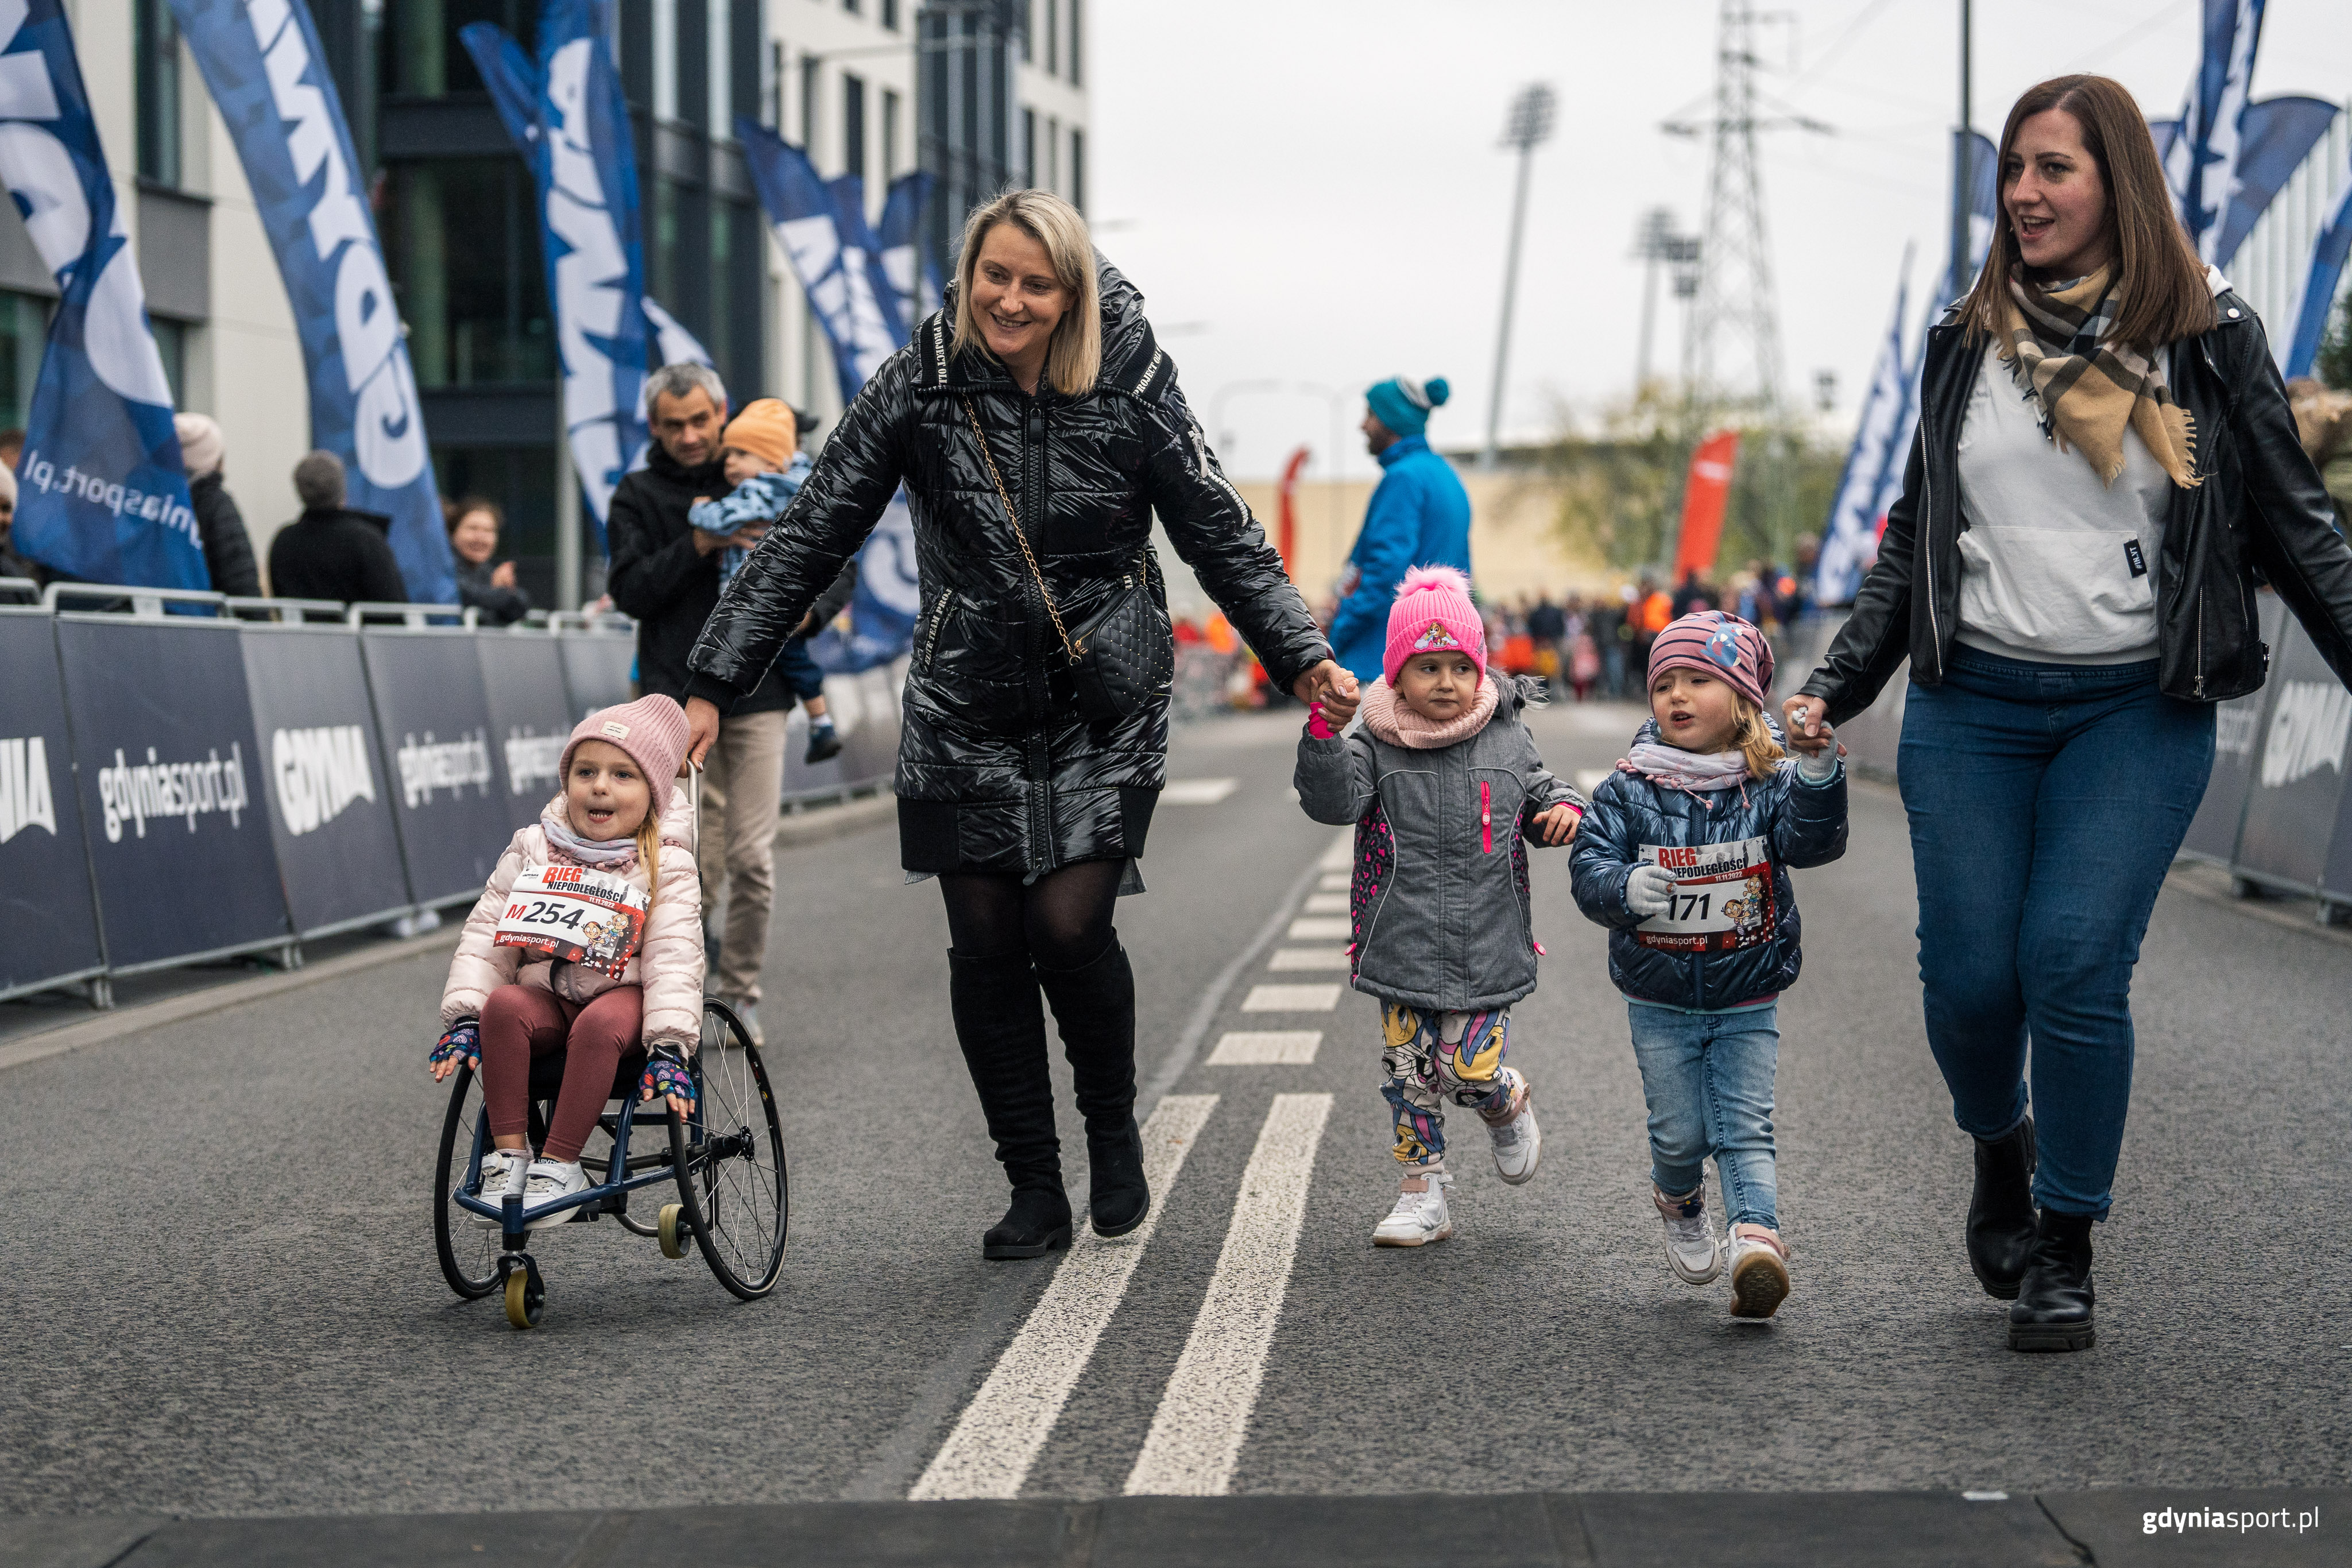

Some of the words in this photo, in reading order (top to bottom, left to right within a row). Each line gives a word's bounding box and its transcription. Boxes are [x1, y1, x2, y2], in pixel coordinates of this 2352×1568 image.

[934, 326, 946, 366] PROJECT
[1132, 363, 1156, 396] PROJECT
[929, 614, 939, 641] TEAM
[925, 641, 934, 665] ELITE
[98, 741, 249, 843] gdyniasport.pl
[272, 725, 377, 836] GDYNIA
[1658, 847, 1697, 869] BIEG
[542, 866, 583, 884] BIEG
[1715, 872, 1743, 882] 11.11.2022
[547, 881, 624, 903] NIEPODLEGŁOŚCI
[589, 896, 616, 909] 11.11.2022
[1669, 893, 1711, 921] 171
[499, 933, 560, 948] gdyniasport.pl
[1646, 935, 1708, 947] gdyniasport.pl
